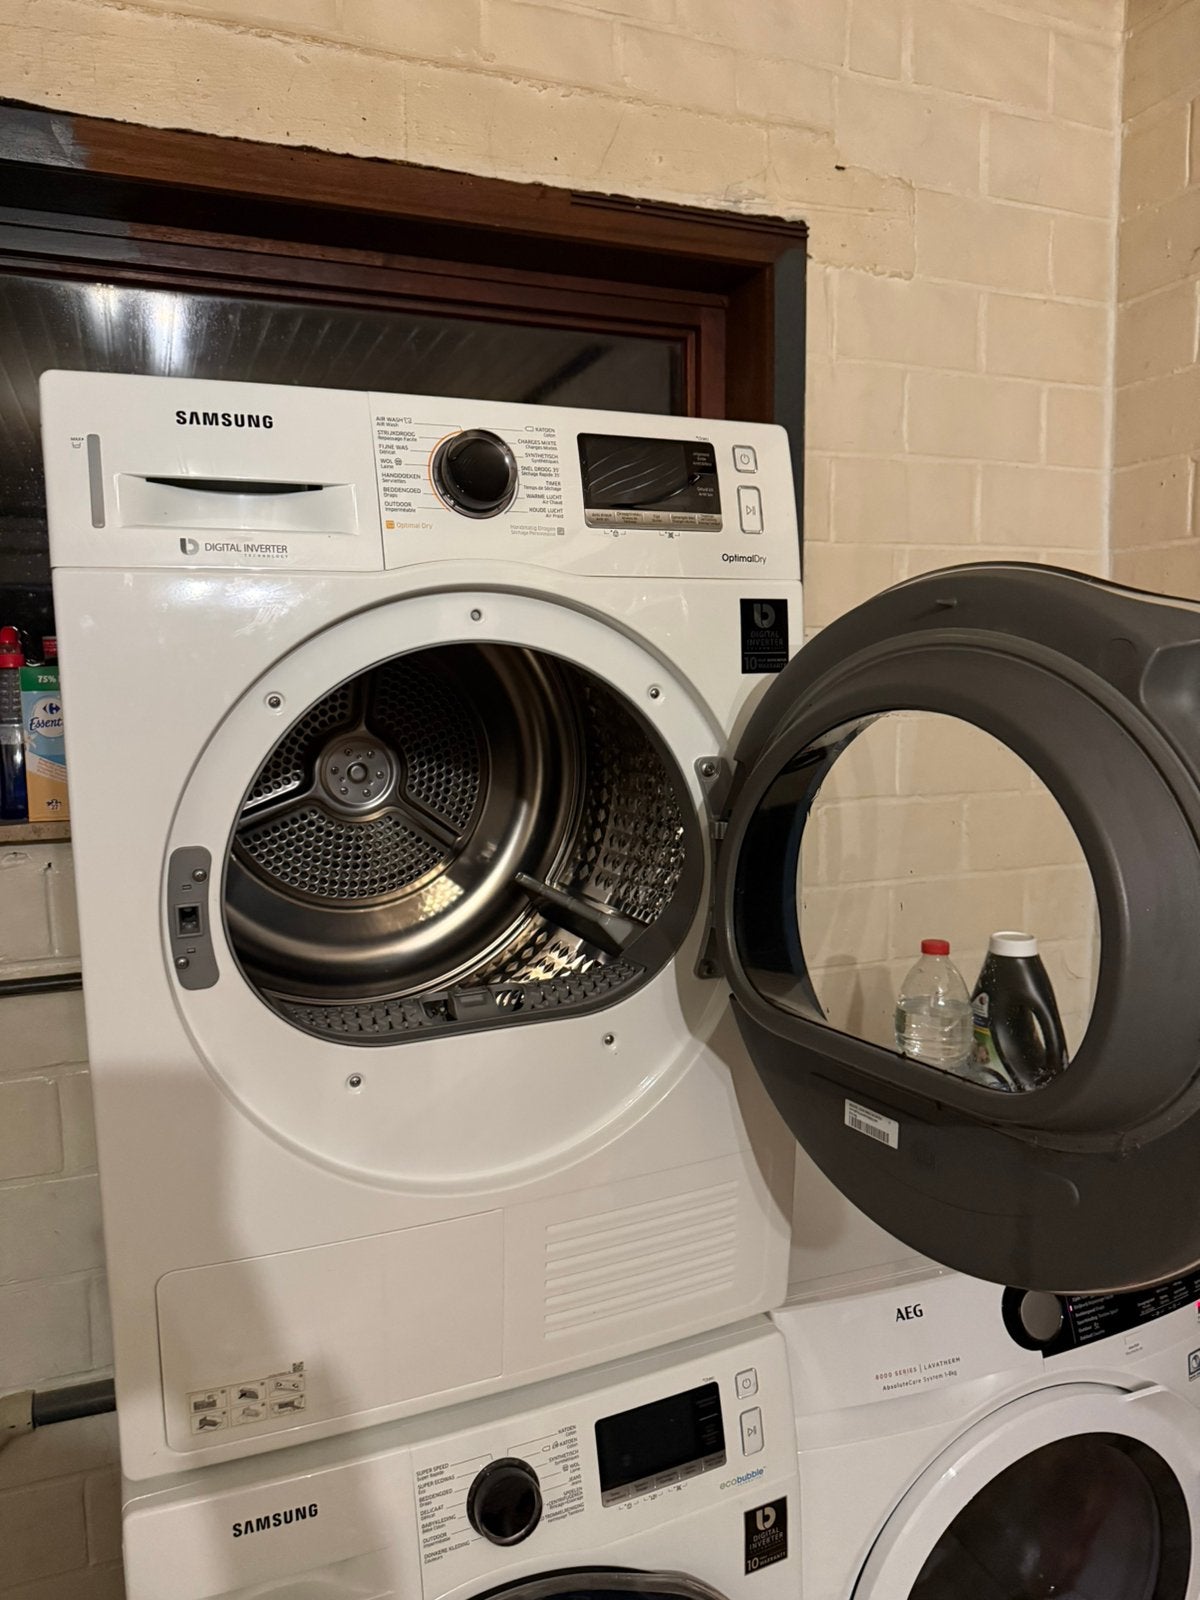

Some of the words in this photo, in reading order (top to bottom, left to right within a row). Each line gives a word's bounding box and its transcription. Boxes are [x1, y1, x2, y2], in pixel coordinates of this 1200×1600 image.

[176, 410, 274, 429] SAMSUNG
[421, 523, 433, 531] Dry
[205, 542, 242, 553] DIGITAL
[243, 545, 288, 554] INVERTER
[722, 553, 767, 565] OptimalDry
[744, 656, 758, 669] 10
[37, 675, 57, 684] 75%
[896, 1303, 924, 1323] AEG
[894, 1366, 918, 1377] SERIES
[923, 1356, 961, 1371] LAVATHERM
[882, 1379, 922, 1392] AbsoluteCare
[232, 1503, 318, 1538] SAMSUNG
[749, 1531, 784, 1550] INVERTER
[752, 1527, 780, 1543] DIGITAL
[747, 1557, 759, 1572] 10
